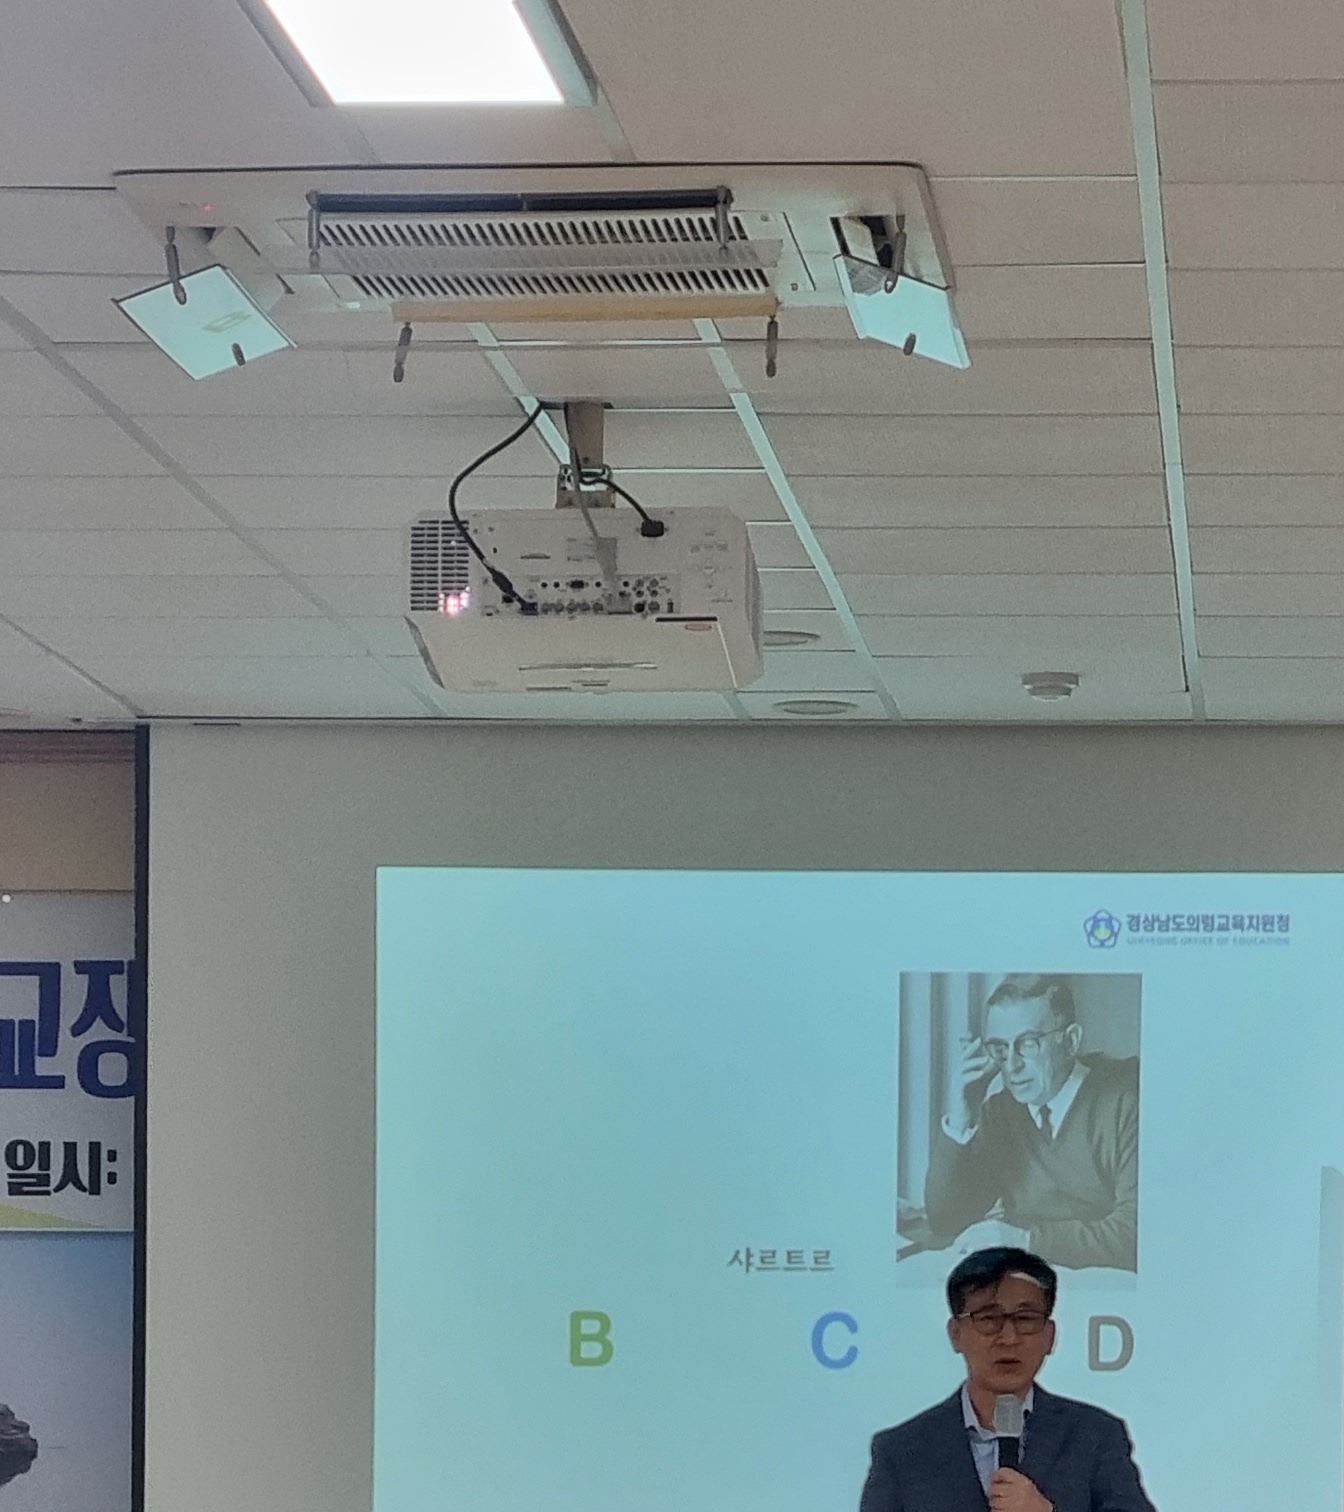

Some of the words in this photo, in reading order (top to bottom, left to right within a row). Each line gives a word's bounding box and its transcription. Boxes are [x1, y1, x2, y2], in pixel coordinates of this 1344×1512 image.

[1126, 914, 1290, 933] 경상남도의령교육지원청
[5, 1139, 118, 1197] 일시:
[727, 1247, 836, 1274] 샤르트르
[568, 1310, 614, 1367] B
[811, 1311, 859, 1369] C
[1088, 1315, 1134, 1371] D
